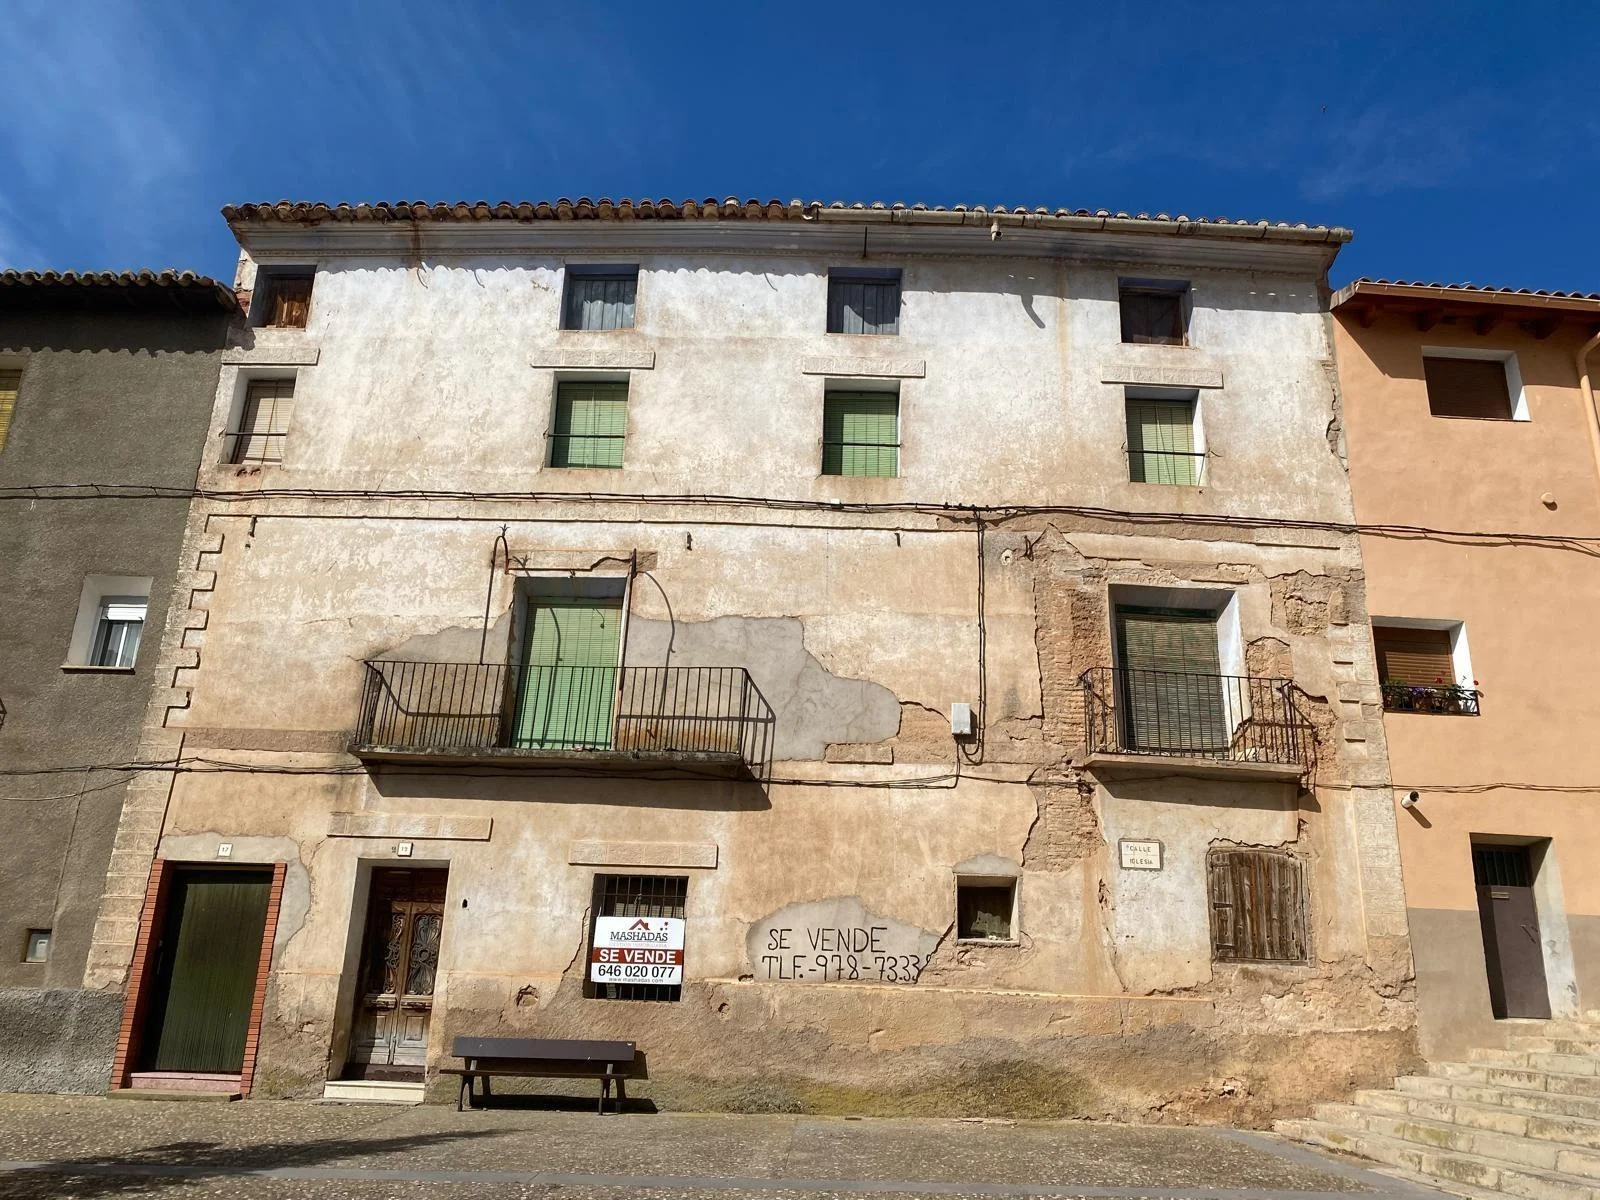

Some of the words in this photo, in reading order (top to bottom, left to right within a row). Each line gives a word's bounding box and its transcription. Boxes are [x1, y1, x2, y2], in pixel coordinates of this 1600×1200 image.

[1129, 845, 1152, 853] CALLE
[609, 931, 669, 942] MASHADAS
[767, 928, 793, 951] SE
[806, 926, 888, 953] VENDE
[599, 949, 620, 962] SE
[623, 949, 676, 964] VENDE
[598, 964, 622, 977] 646
[624, 965, 648, 978] 020
[651, 966, 675, 978] 077
